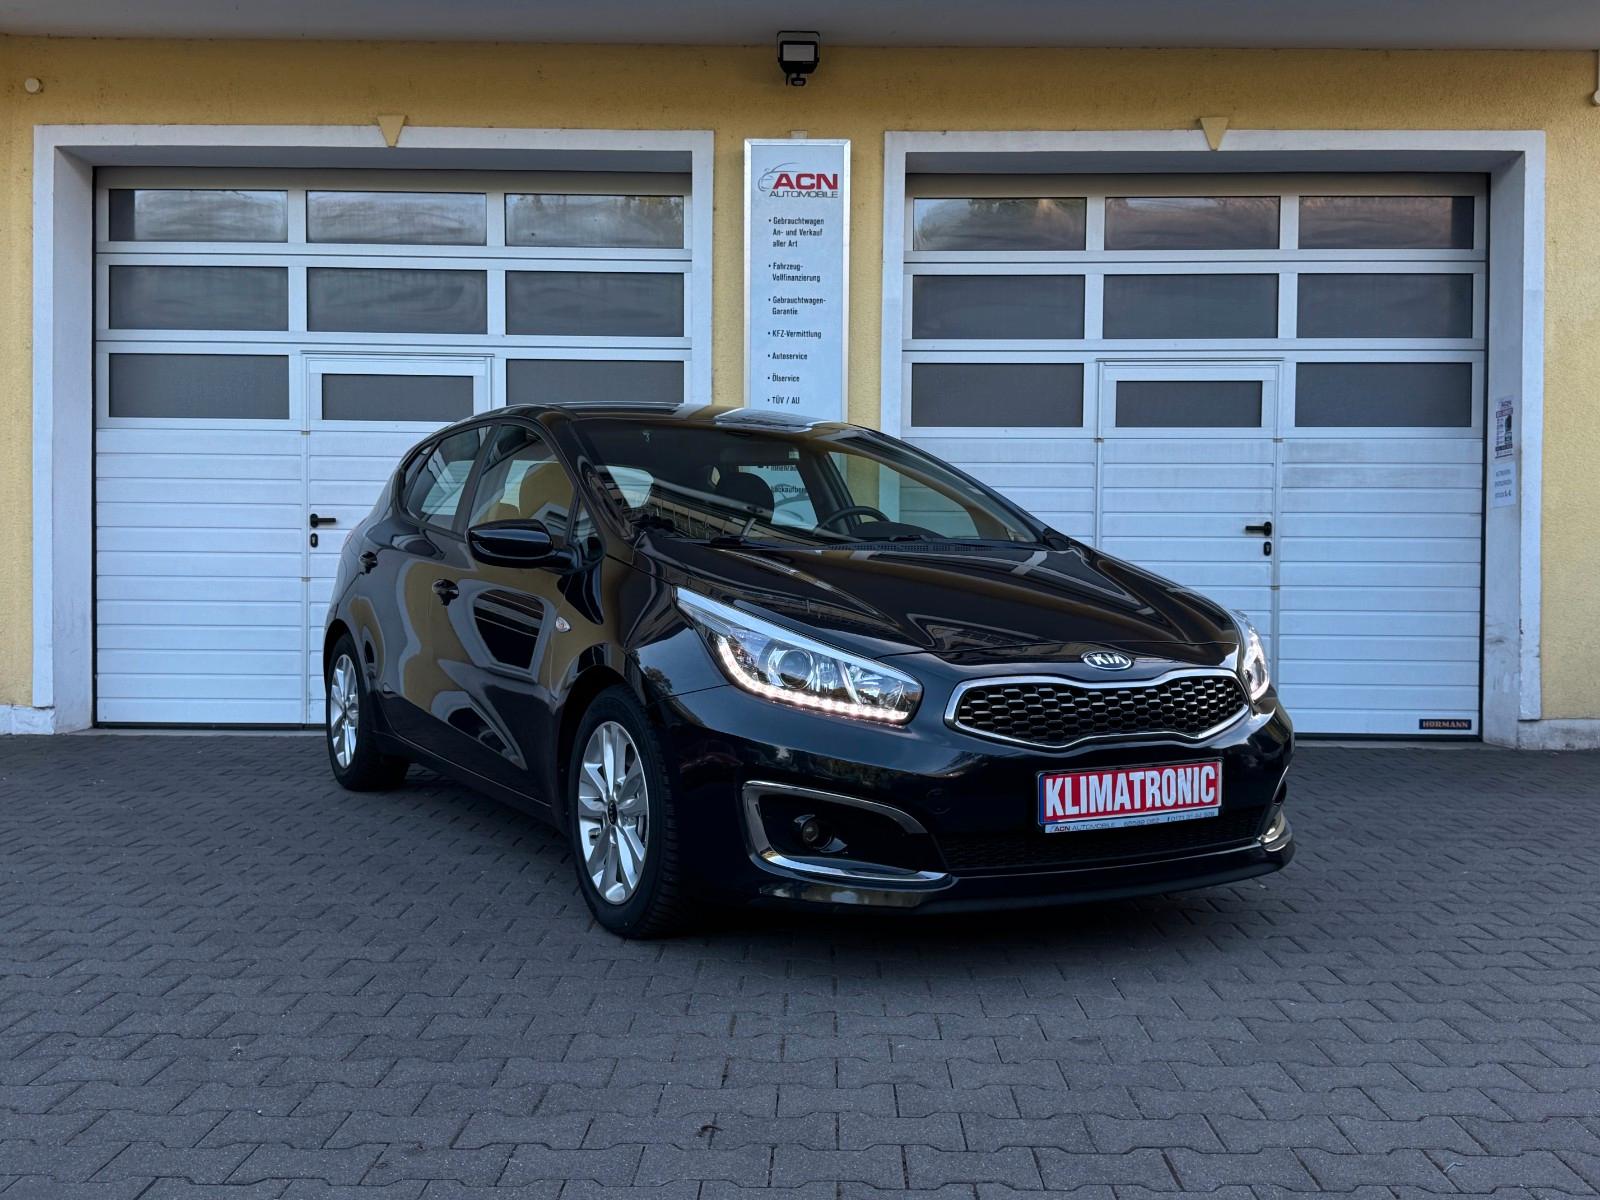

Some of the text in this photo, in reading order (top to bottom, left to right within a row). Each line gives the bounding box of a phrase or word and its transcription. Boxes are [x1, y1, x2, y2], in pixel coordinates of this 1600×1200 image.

[772, 173, 838, 190] ACN
[769, 190, 838, 199] AUTOMOBILE
[773, 217, 824, 227] Gebrauchtwagen
[772, 228, 823, 236] An- und Verkauf
[772, 240, 798, 248] aller Art
[773, 262, 804, 271] Fahrzeug-
[772, 273, 821, 283] Vollfinanzierung
[772, 296, 827, 306] Gebrauchtwagen-
[772, 307, 798, 315] Garantie
[772, 329, 822, 339] KFZ-Vermittlung
[772, 352, 808, 360] Autoservice
[772, 373, 800, 382] Ölservice
[772, 396, 785, 404] TÜV
[791, 396, 800, 404] AU
[1089, 653, 1128, 665] KIA
[1045, 765, 1216, 817] KLIMATRONIC
